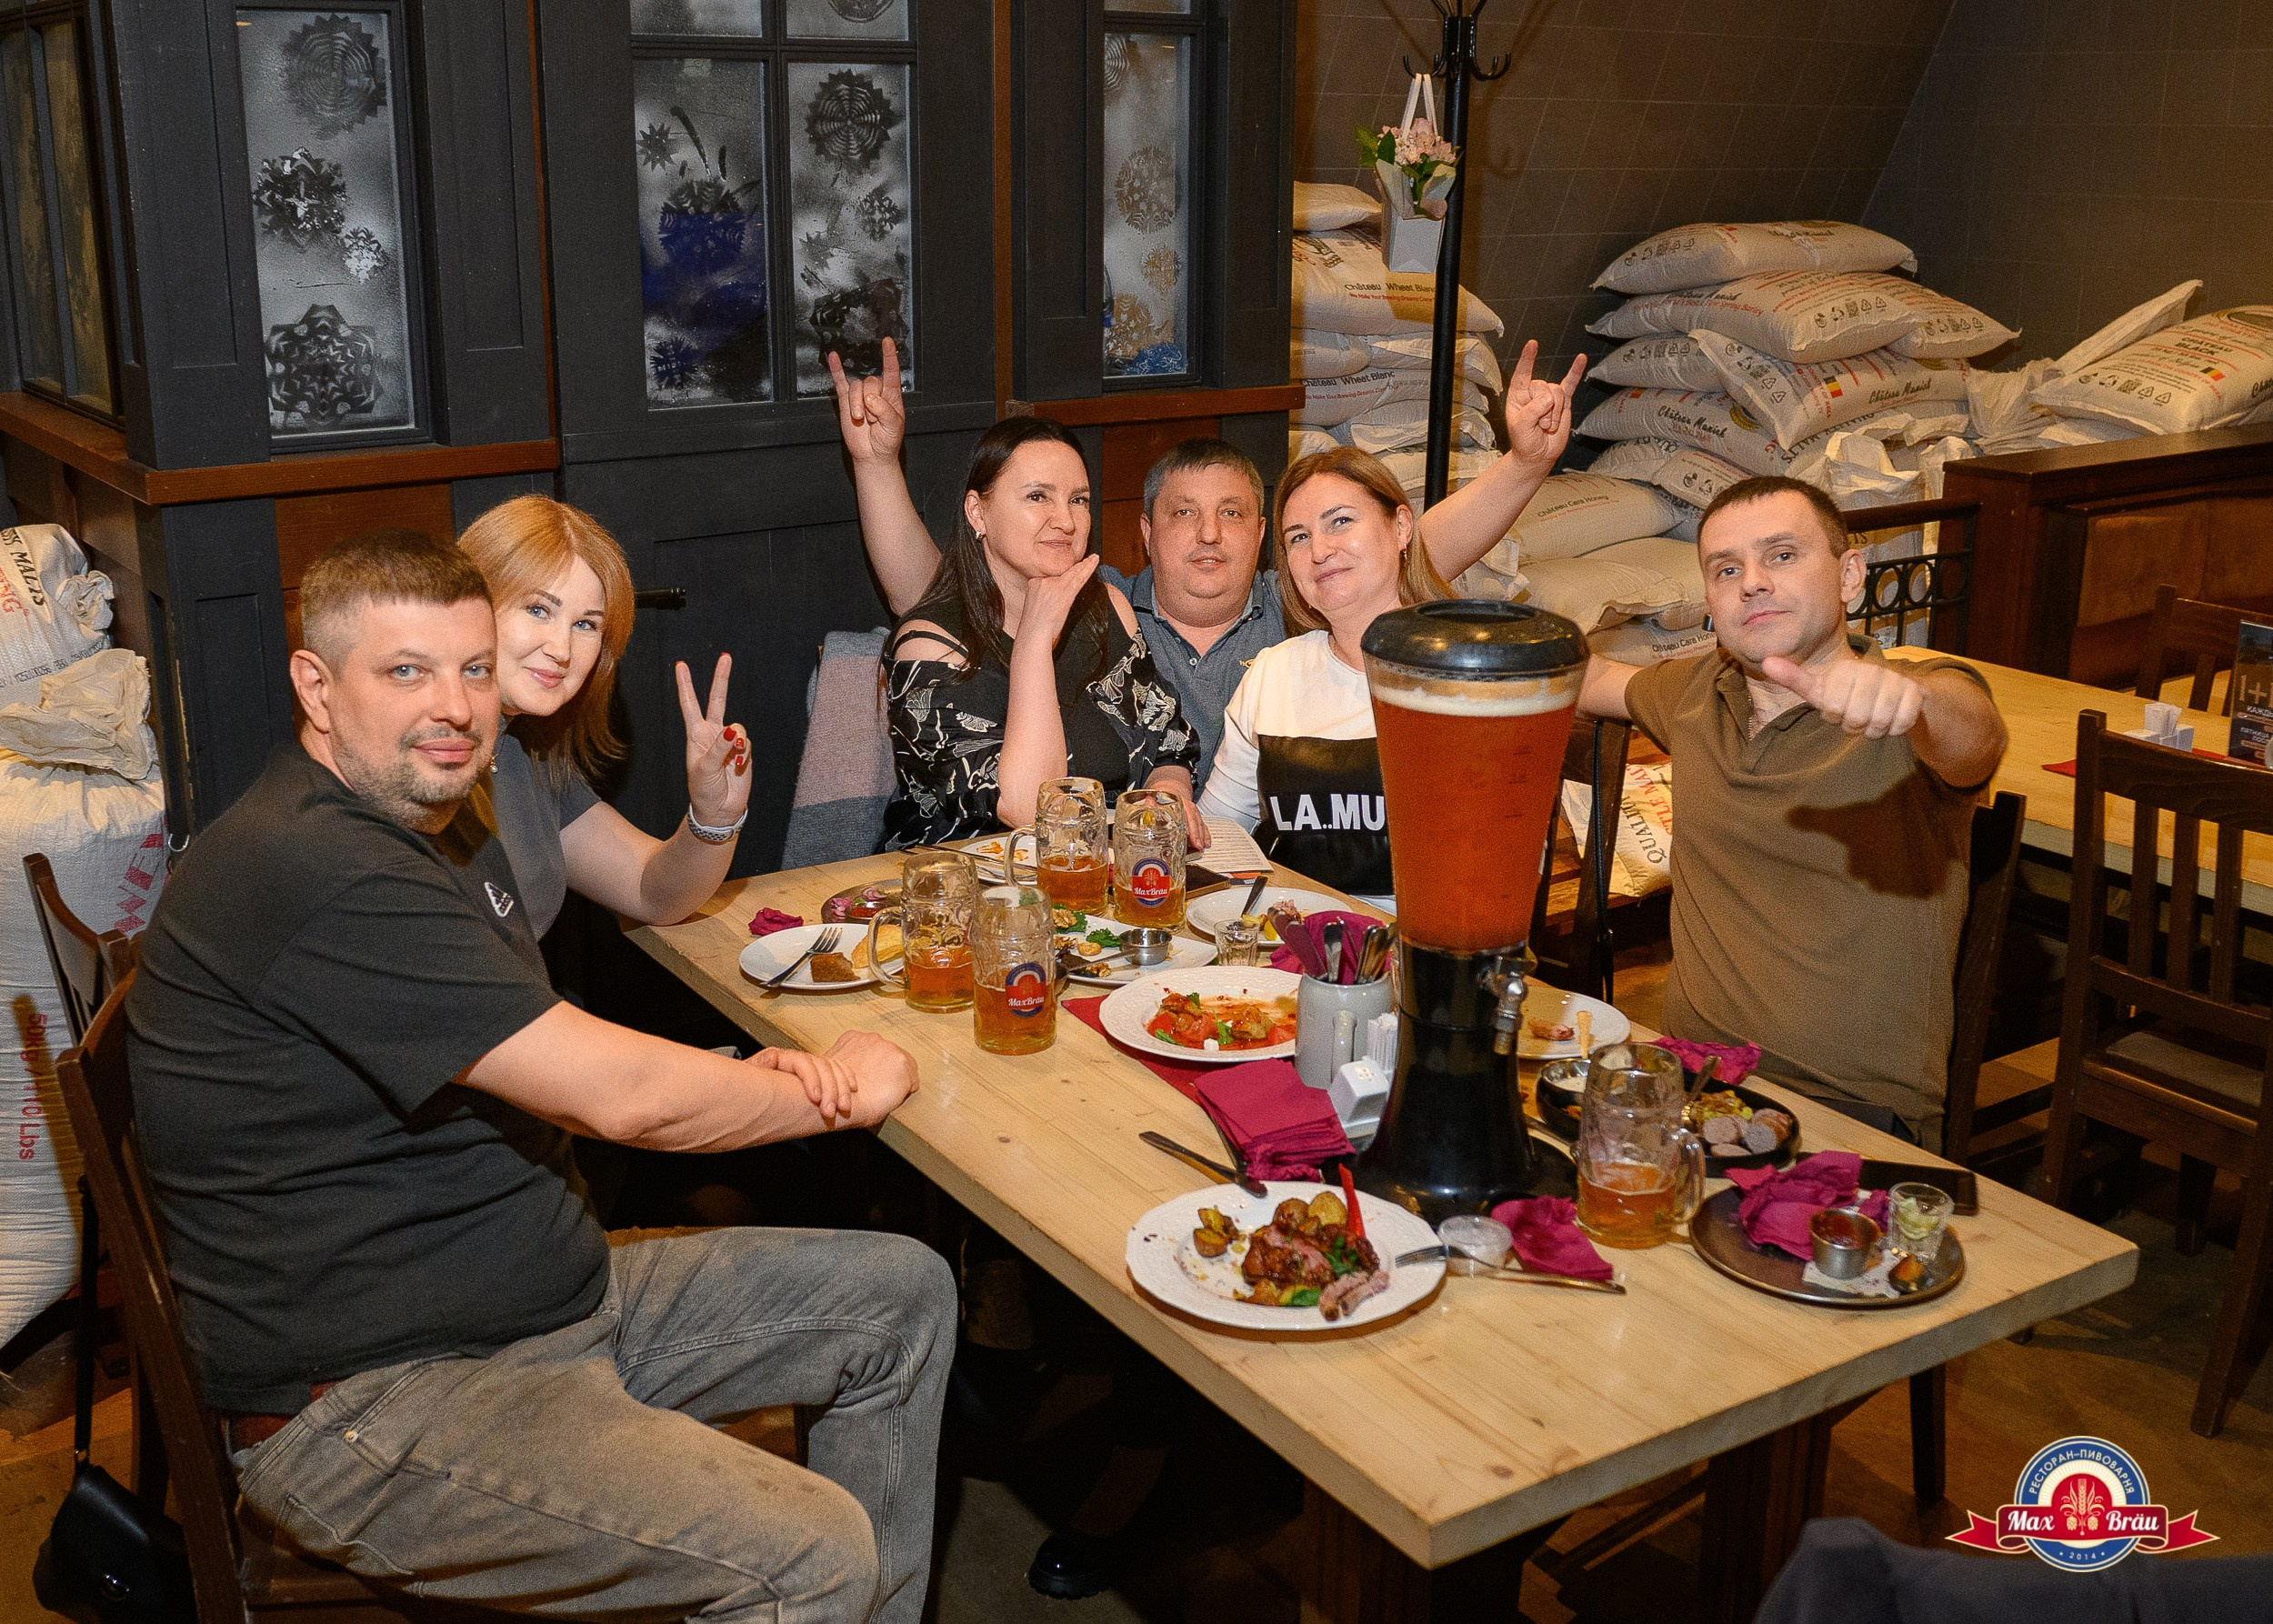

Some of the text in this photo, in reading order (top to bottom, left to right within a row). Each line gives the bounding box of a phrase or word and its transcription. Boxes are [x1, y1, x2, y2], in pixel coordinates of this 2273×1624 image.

[1385, 282, 1415, 292] Wheat
[1341, 375, 1372, 386] Wheat
[1370, 370, 1396, 381] Blanc
[10, 551, 45, 606] MALTS
[1679, 637, 1698, 647] Cara
[1619, 795, 1667, 865] QUALITY
[19, 1122, 42, 1161] Lbs
